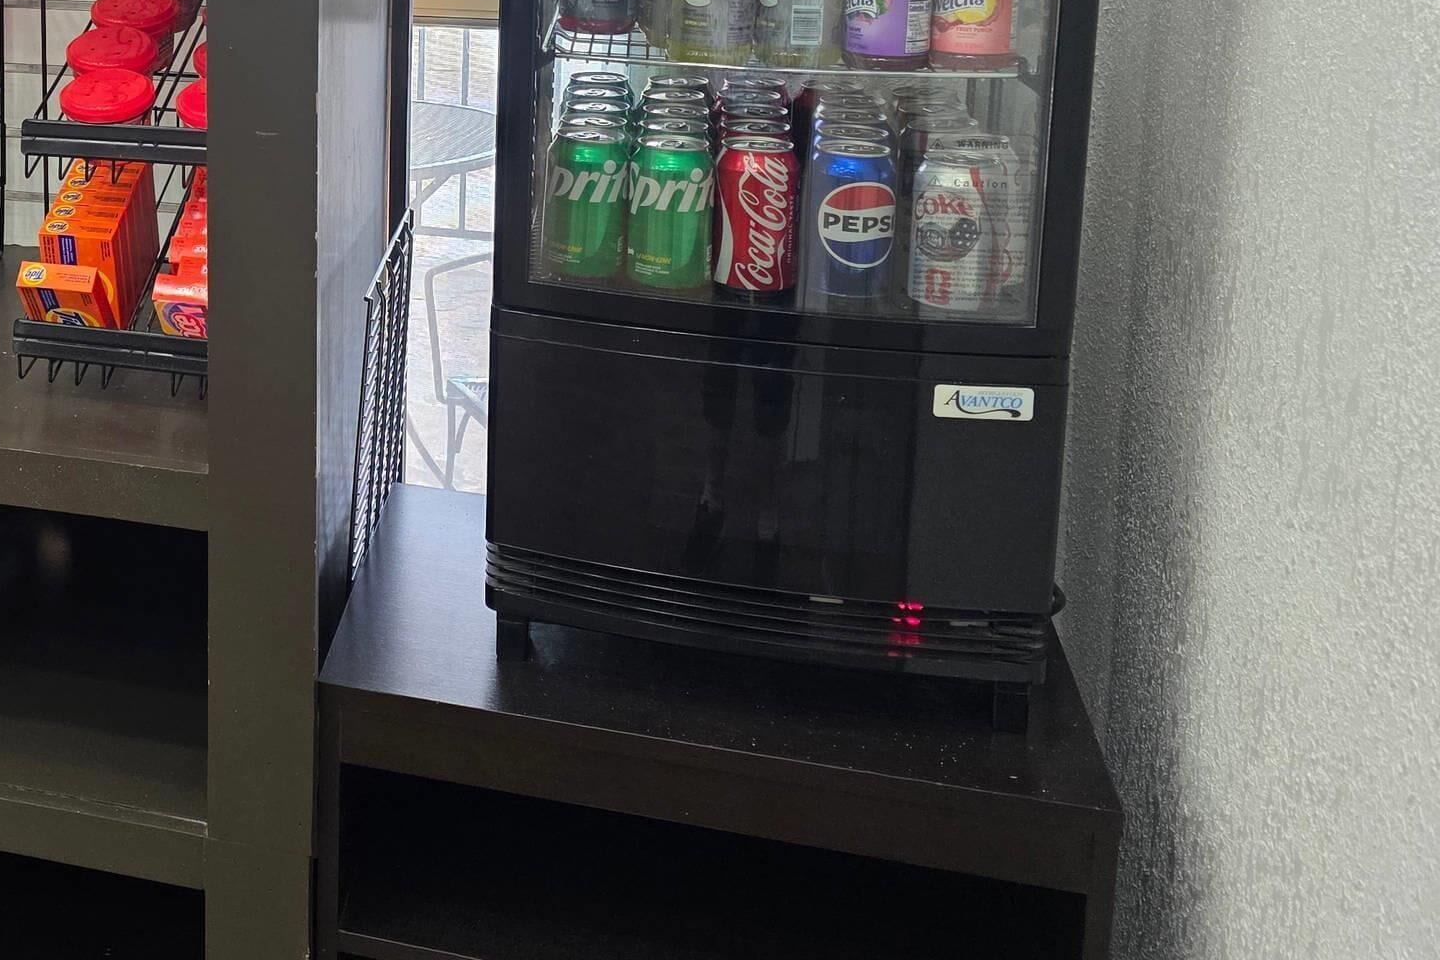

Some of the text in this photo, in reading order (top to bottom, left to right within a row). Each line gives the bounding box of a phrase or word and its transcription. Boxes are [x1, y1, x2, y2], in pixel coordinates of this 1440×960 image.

[957, 140, 1009, 150] WARNING
[548, 159, 628, 204] prit
[953, 178, 1007, 189] Caution
[943, 390, 1024, 417] AVANTCO
